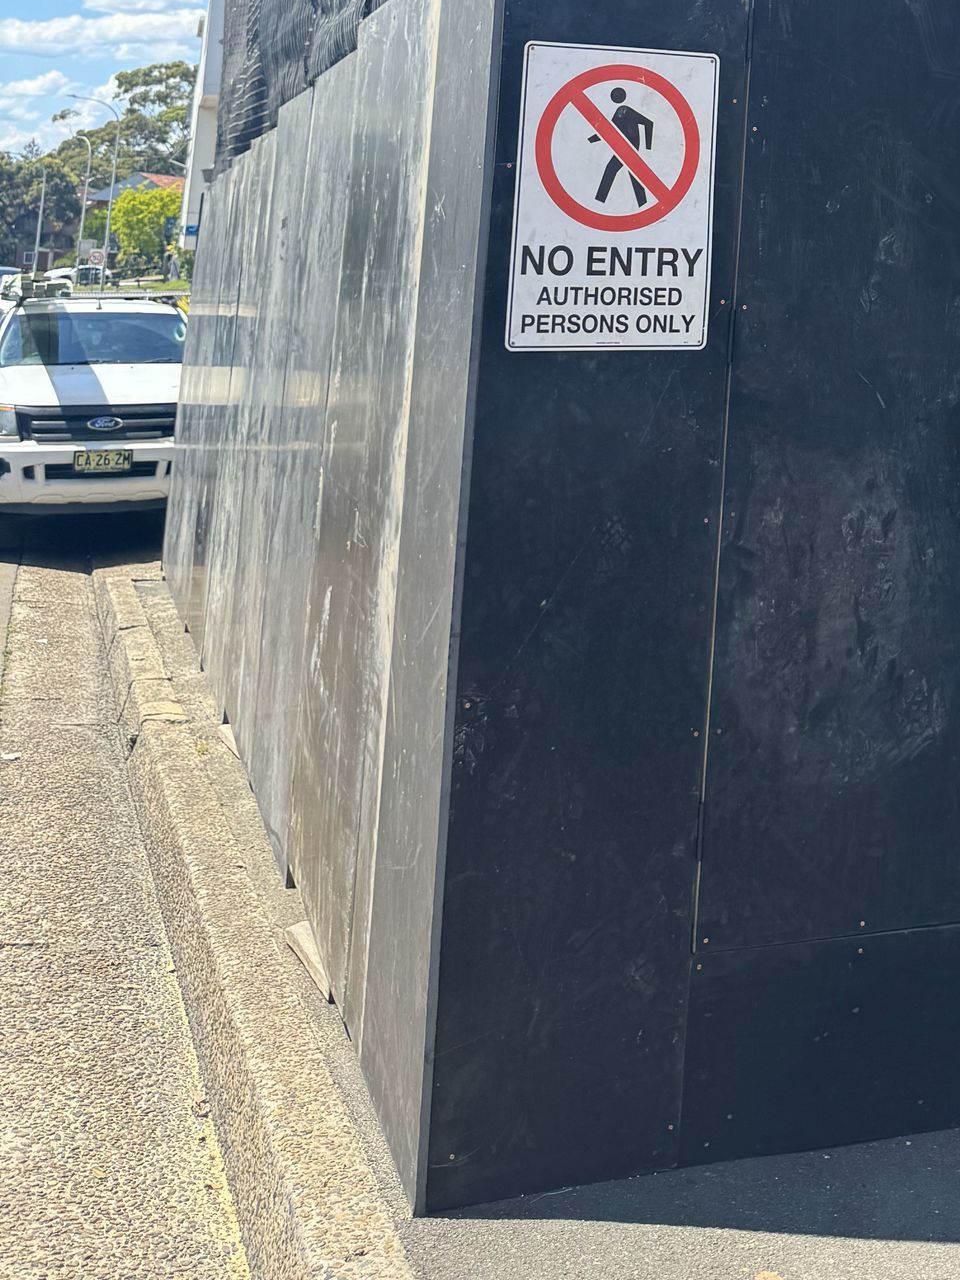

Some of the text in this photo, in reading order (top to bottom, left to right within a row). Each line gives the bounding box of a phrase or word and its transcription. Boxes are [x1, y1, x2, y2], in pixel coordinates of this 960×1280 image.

[520, 245, 704, 277] NO ENTRY
[536, 286, 683, 306] AUTHORISED
[520, 314, 696, 334] PERSONS ONLY
